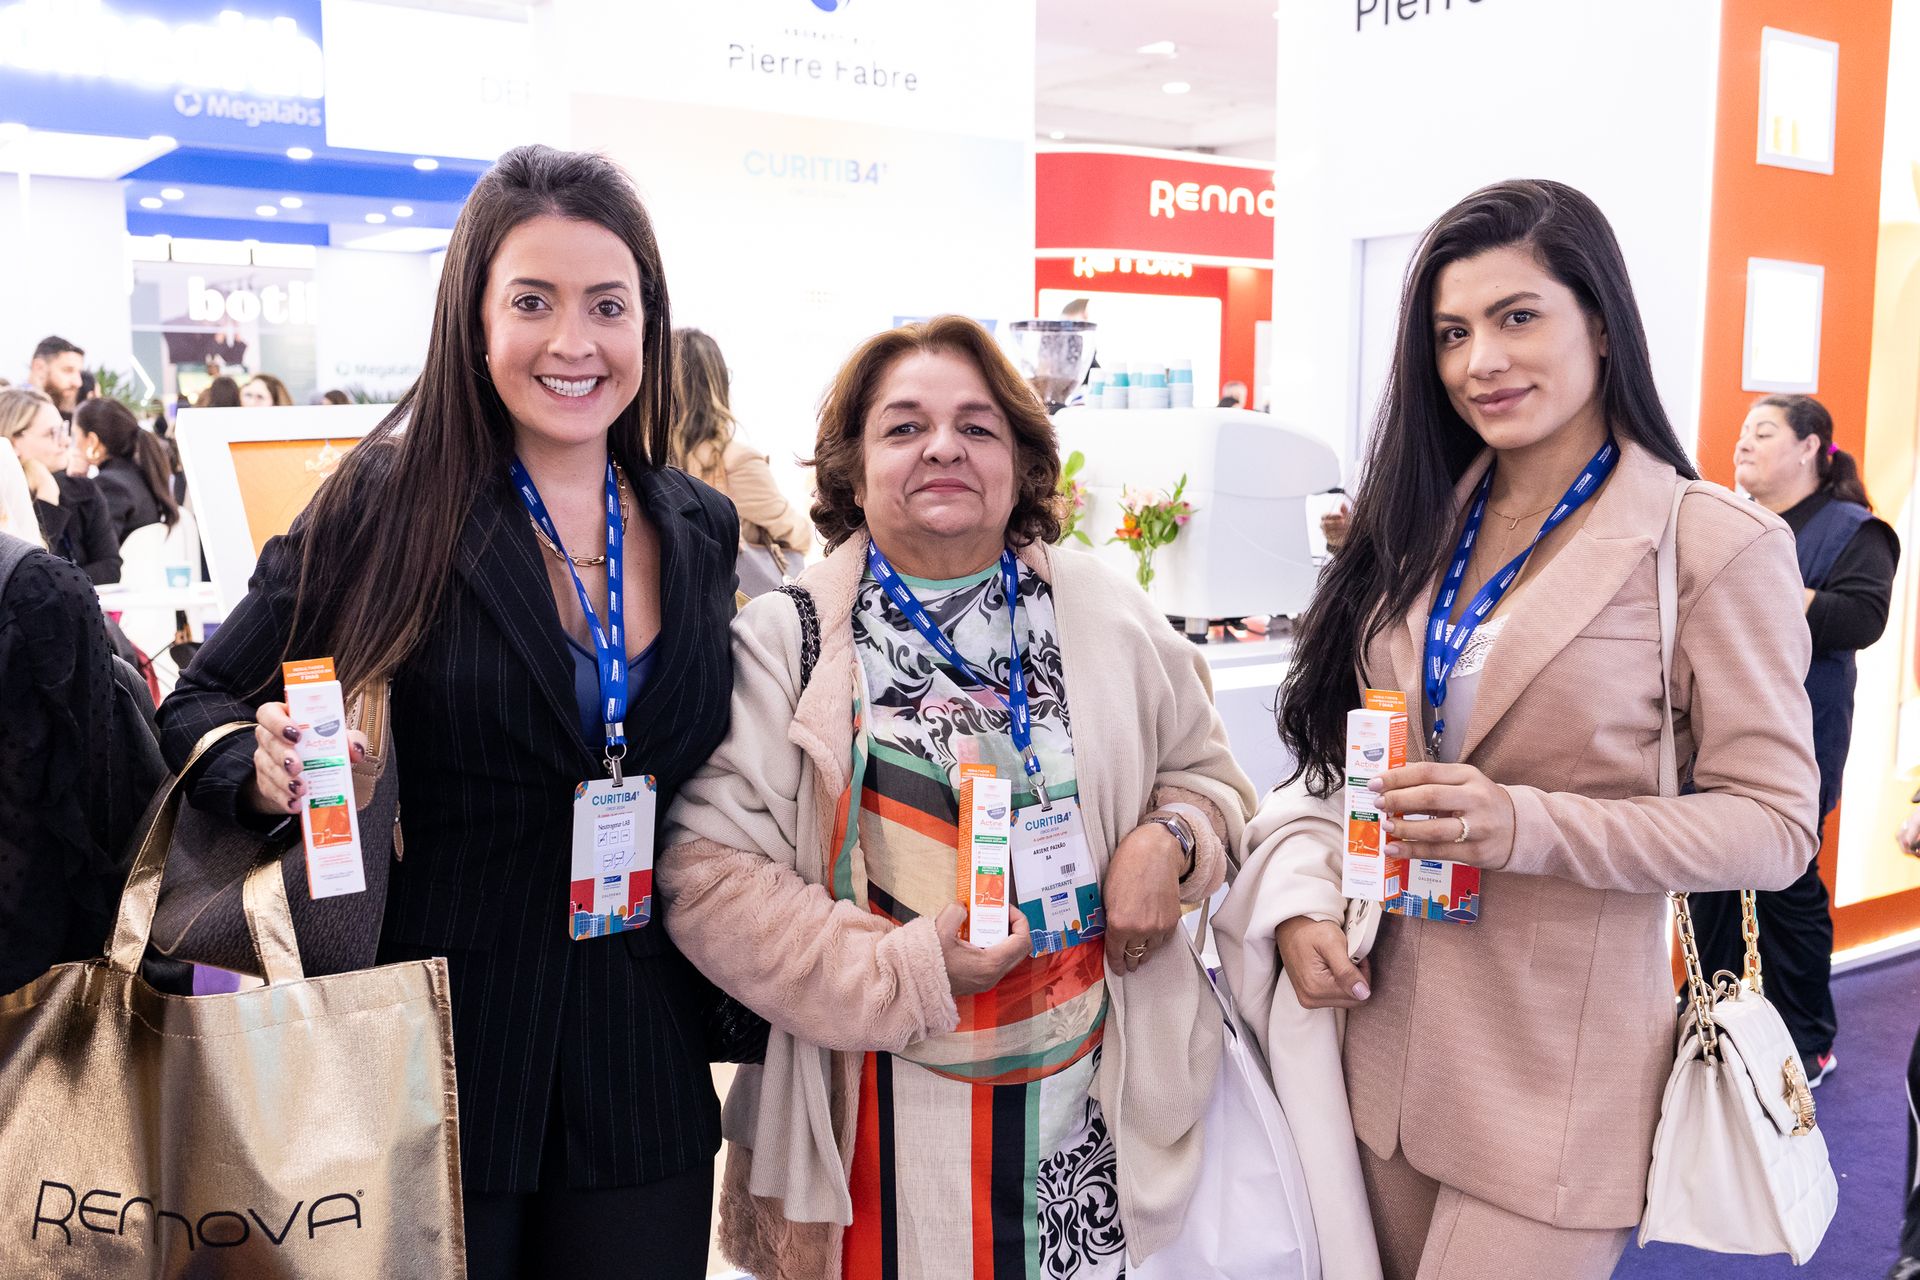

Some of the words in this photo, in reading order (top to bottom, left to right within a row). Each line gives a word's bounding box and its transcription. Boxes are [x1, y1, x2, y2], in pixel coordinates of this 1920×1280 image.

[729, 43, 821, 79] Pierre
[206, 94, 322, 128] Megalabs
[1041, 879, 1072, 892] PALESTRANTE
